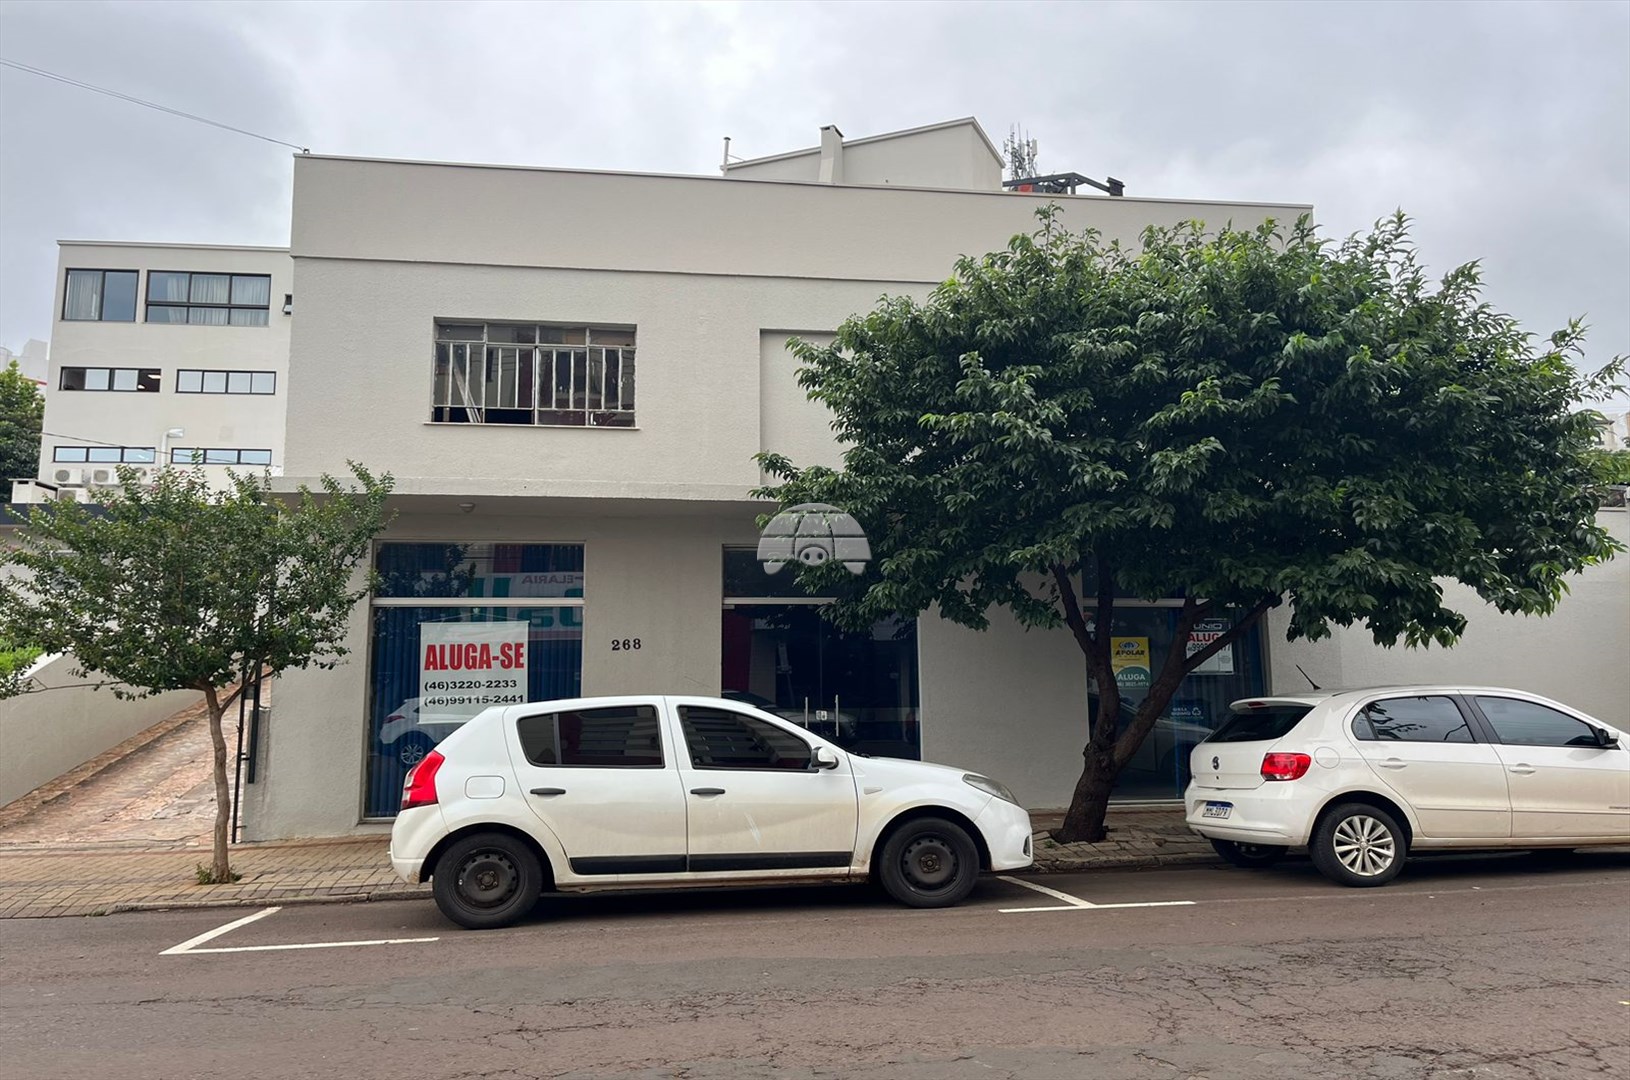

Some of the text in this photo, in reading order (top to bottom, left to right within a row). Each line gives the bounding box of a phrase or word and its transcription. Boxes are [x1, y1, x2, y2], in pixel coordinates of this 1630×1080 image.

[611, 638, 642, 651] 268
[424, 642, 525, 671] ALUGA-SE
[1117, 673, 1146, 681] ALUGA
[424, 680, 518, 692] (46)3220-2233
[424, 694, 525, 707] (46)99115-2441
